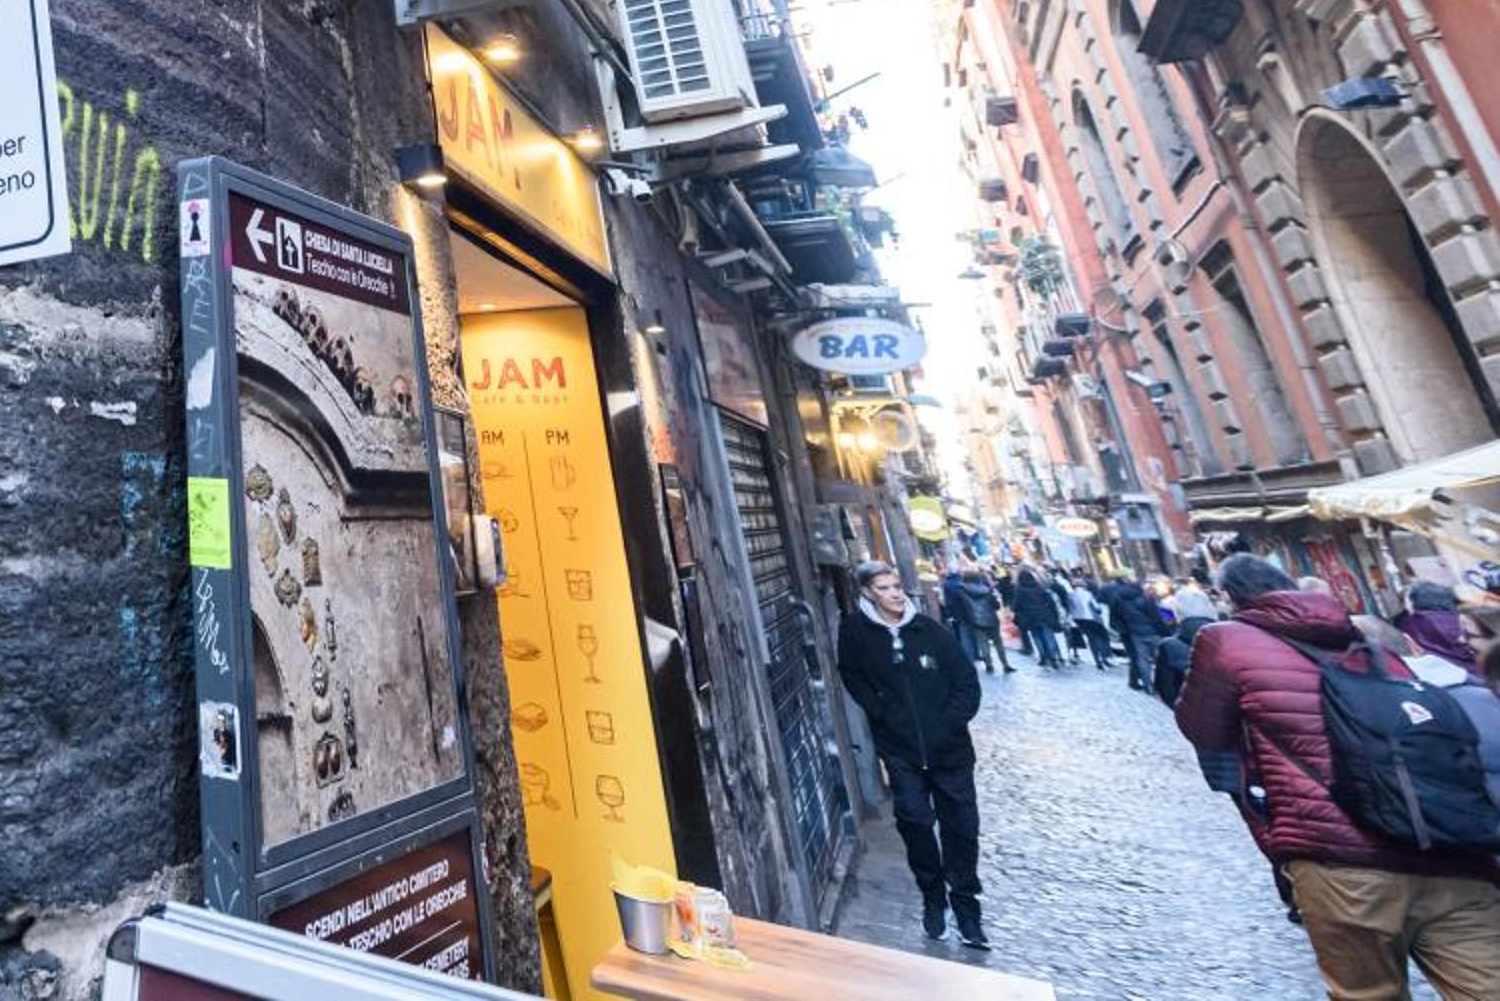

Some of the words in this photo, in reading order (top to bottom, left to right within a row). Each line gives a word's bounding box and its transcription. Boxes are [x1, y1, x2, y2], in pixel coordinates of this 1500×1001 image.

[818, 334, 900, 359] BAR
[471, 356, 567, 390] JAM
[481, 429, 505, 446] AM
[545, 429, 570, 446] PM
[305, 904, 350, 941] SCENDI
[409, 858, 449, 894] CIMITERO
[349, 918, 393, 950] TESCHIO
[393, 908, 413, 935] CON
[413, 901, 426, 923] LE
[425, 878, 468, 918] ORECCHIE
